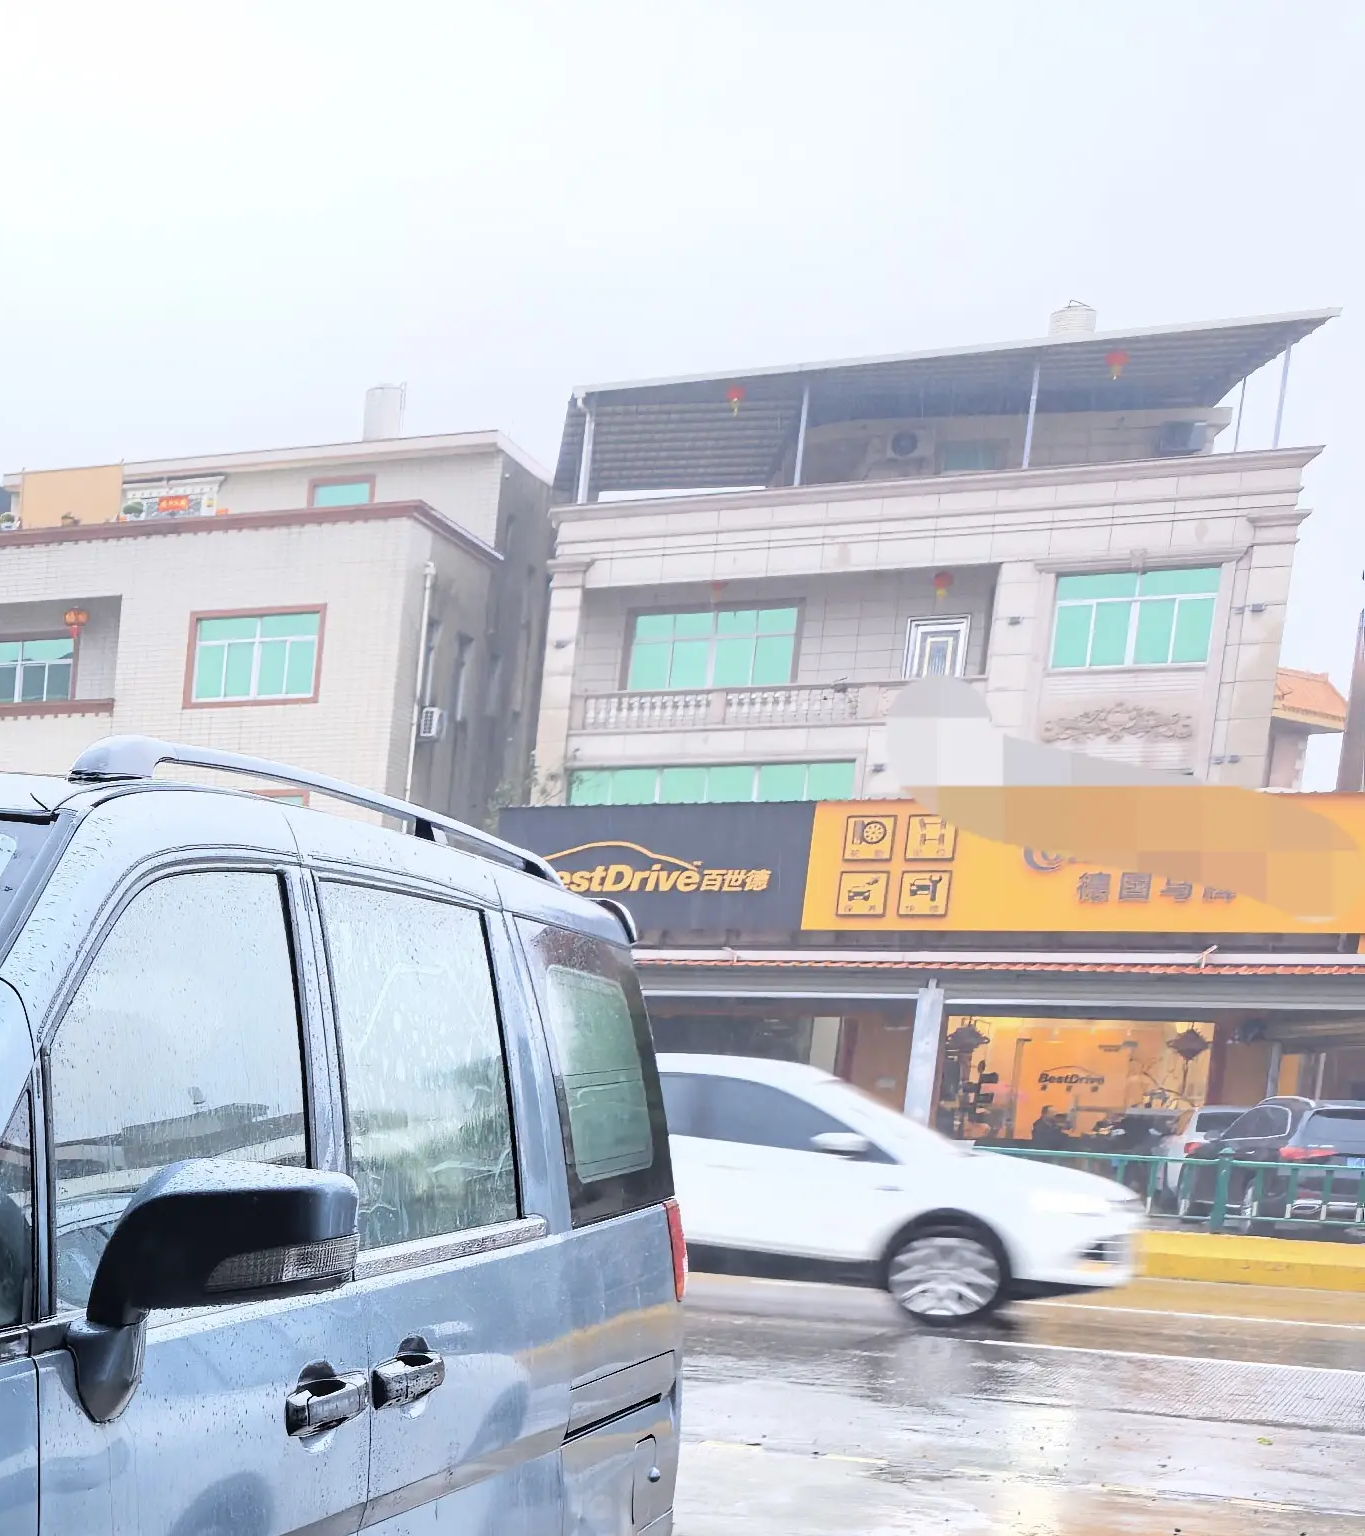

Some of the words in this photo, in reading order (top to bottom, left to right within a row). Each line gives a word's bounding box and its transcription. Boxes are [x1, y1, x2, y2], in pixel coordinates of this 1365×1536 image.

[556, 863, 702, 892] estDrive
[700, 869, 772, 892] 百世德
